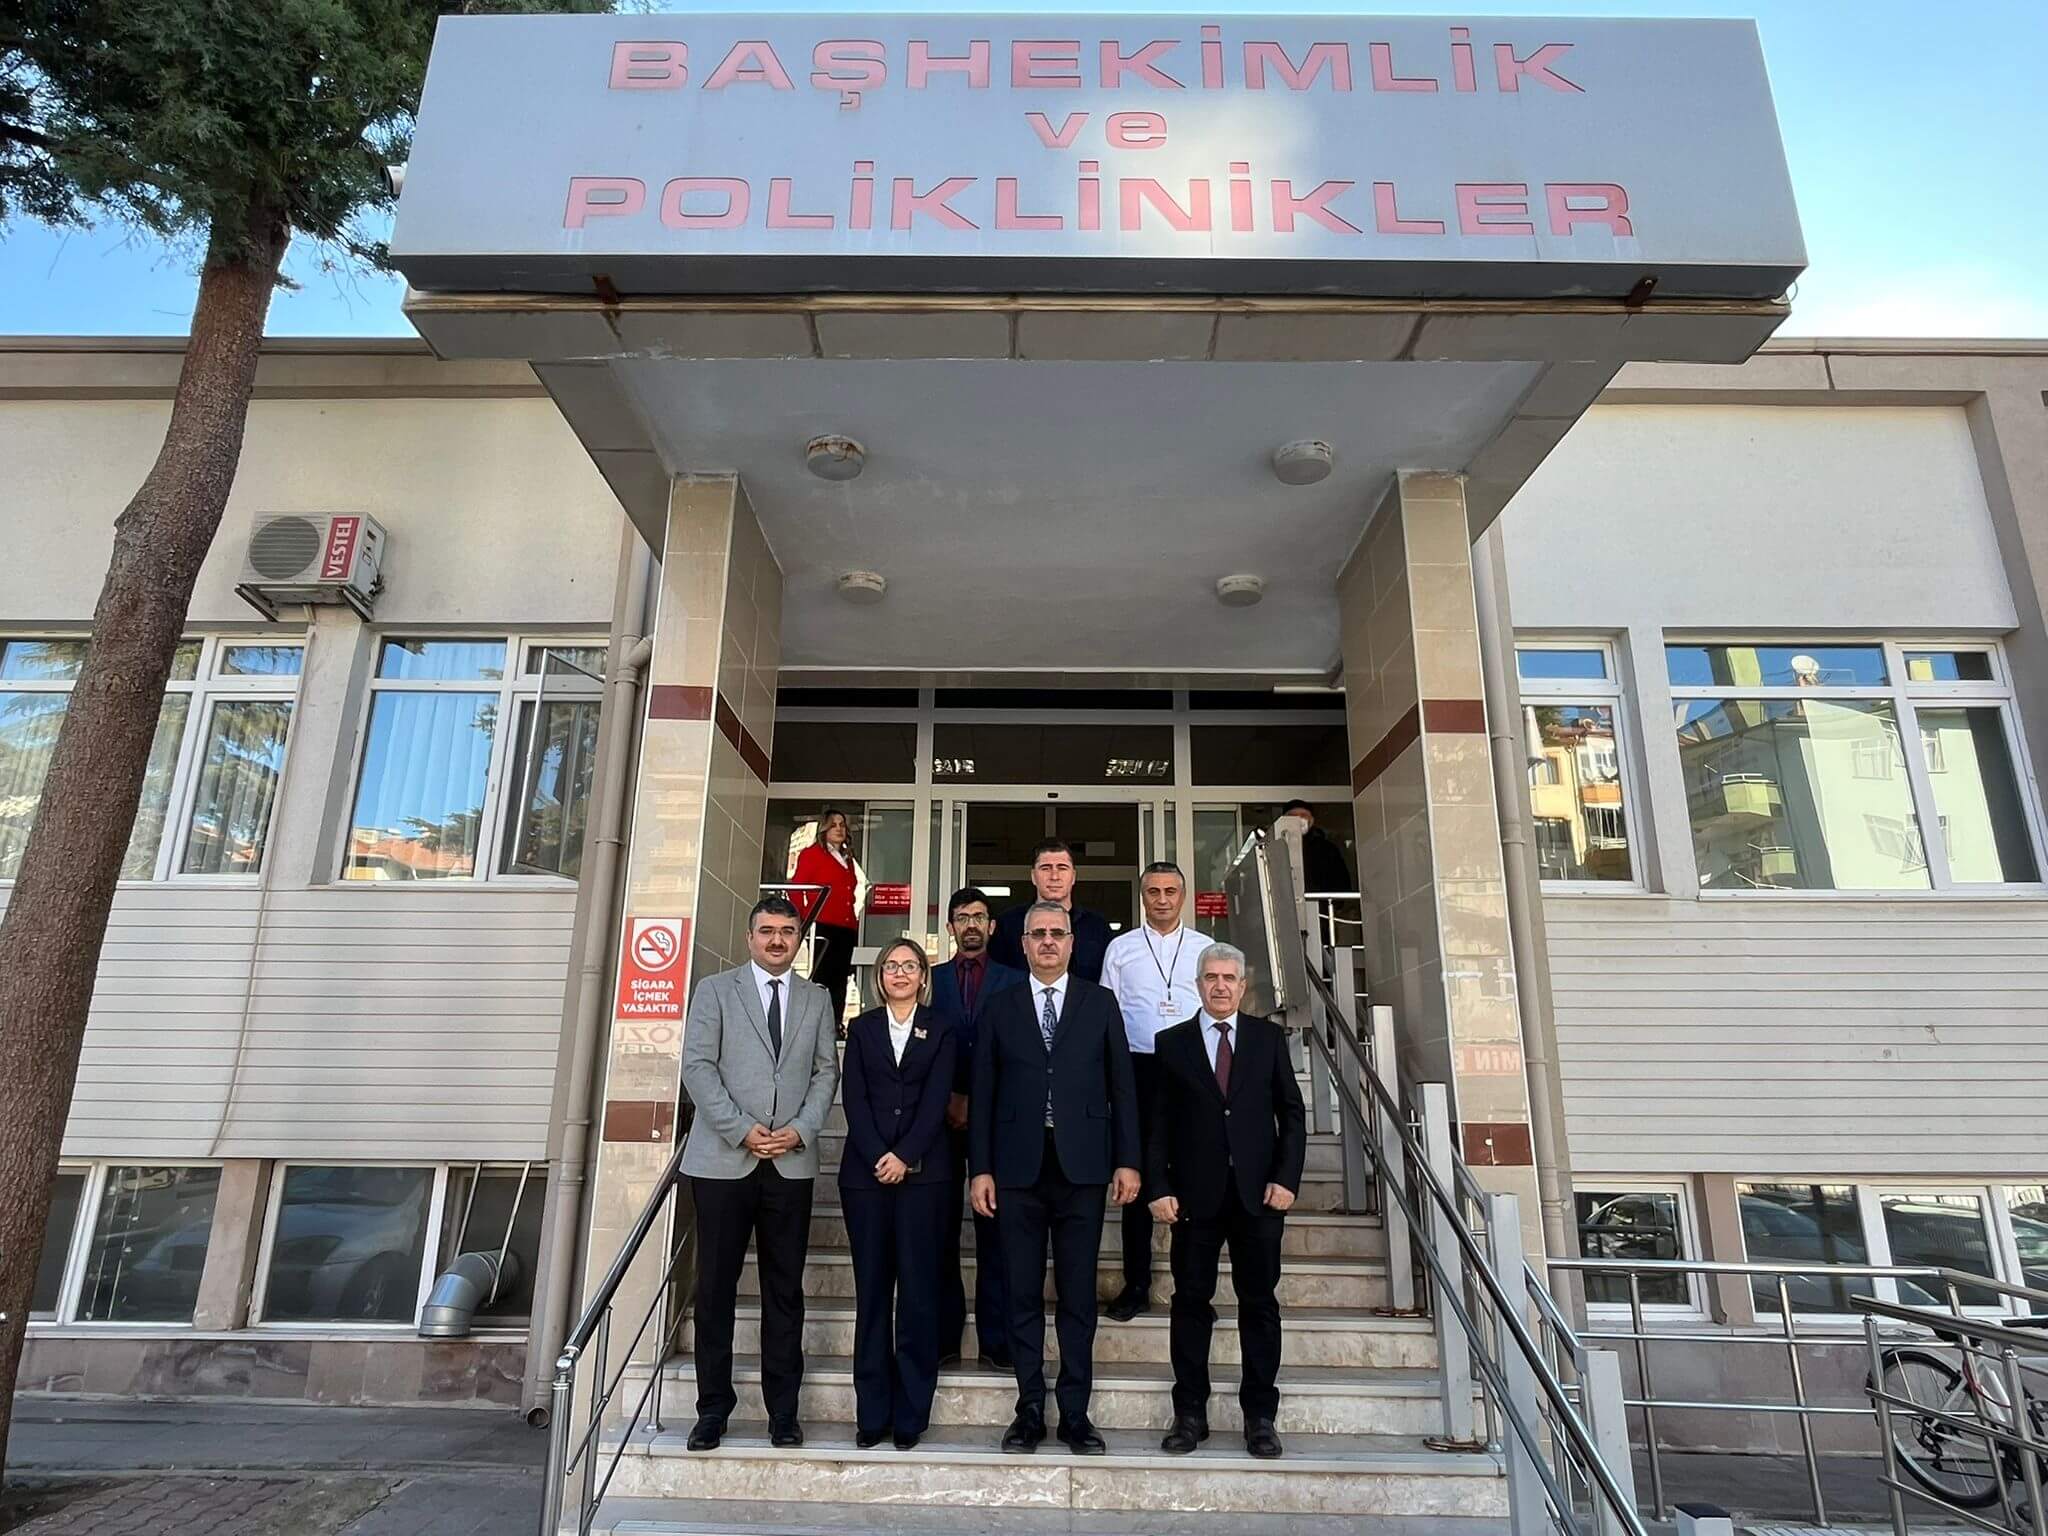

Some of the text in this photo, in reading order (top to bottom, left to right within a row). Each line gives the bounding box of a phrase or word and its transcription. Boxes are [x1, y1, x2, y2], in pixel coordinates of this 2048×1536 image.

[607, 25, 1586, 111] BAŞHEKİMLİK
[1025, 111, 1168, 149] ve
[563, 160, 1634, 237] POLİKLİNİKLER
[327, 519, 353, 577] VESTEL
[630, 978, 675, 990] SİGARA
[633, 989, 670, 1002] İÇMEK
[622, 1002, 680, 1013] YASAKTIR
